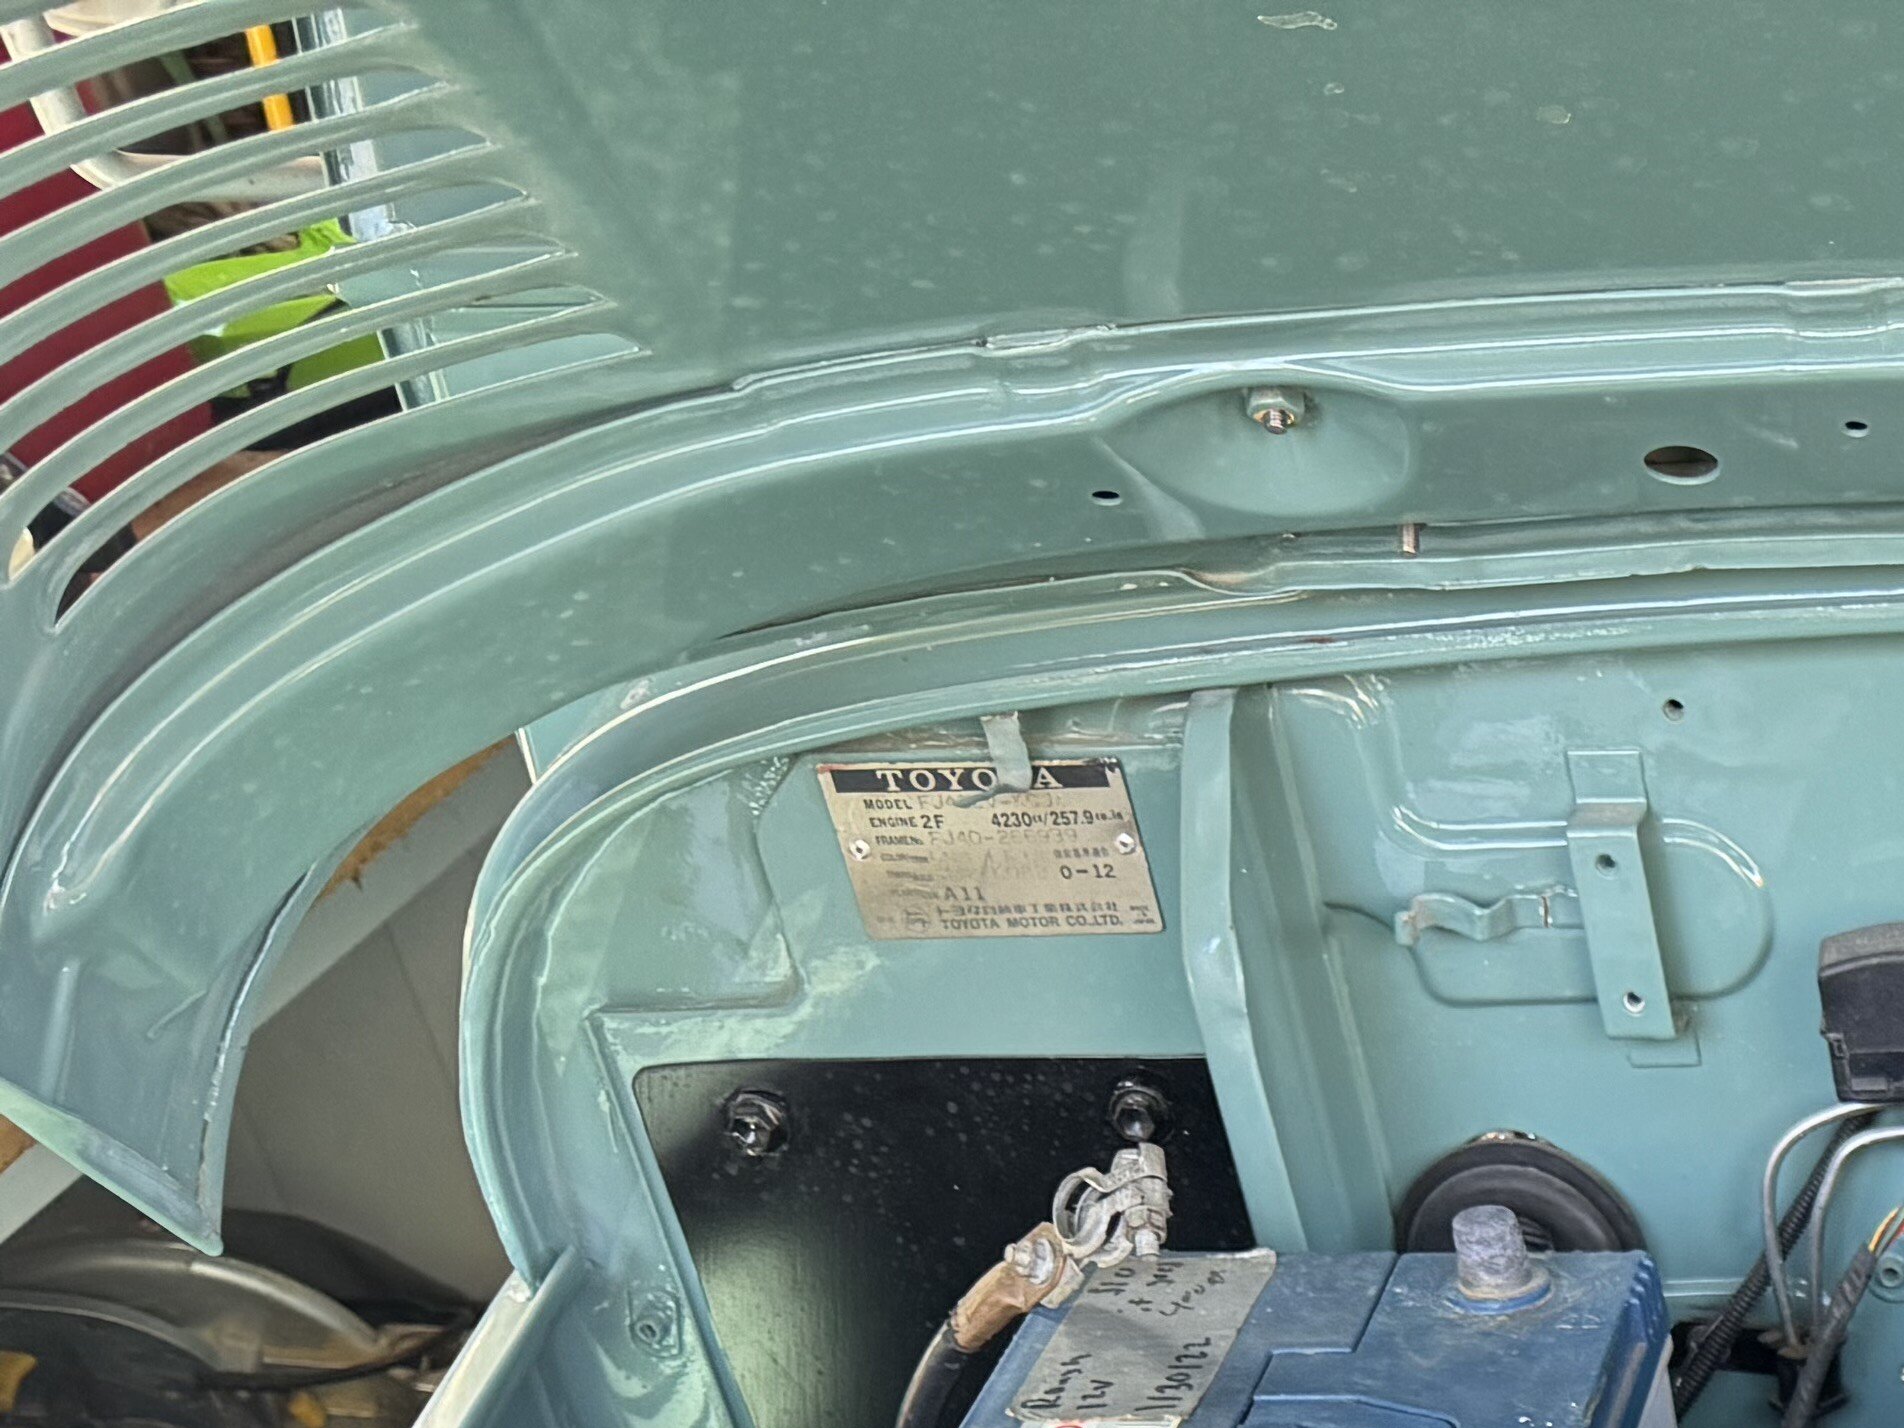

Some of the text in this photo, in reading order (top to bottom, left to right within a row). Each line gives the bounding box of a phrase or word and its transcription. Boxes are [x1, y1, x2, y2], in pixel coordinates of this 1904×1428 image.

[876, 767, 1064, 792] TOYOA
[864, 798, 913, 811] MODEL
[869, 816, 918, 828] ENGINE
[922, 814, 945, 829] 2F
[942, 917, 1000, 930] TOYOTA
[1006, 916, 1063, 929] MOTOR
